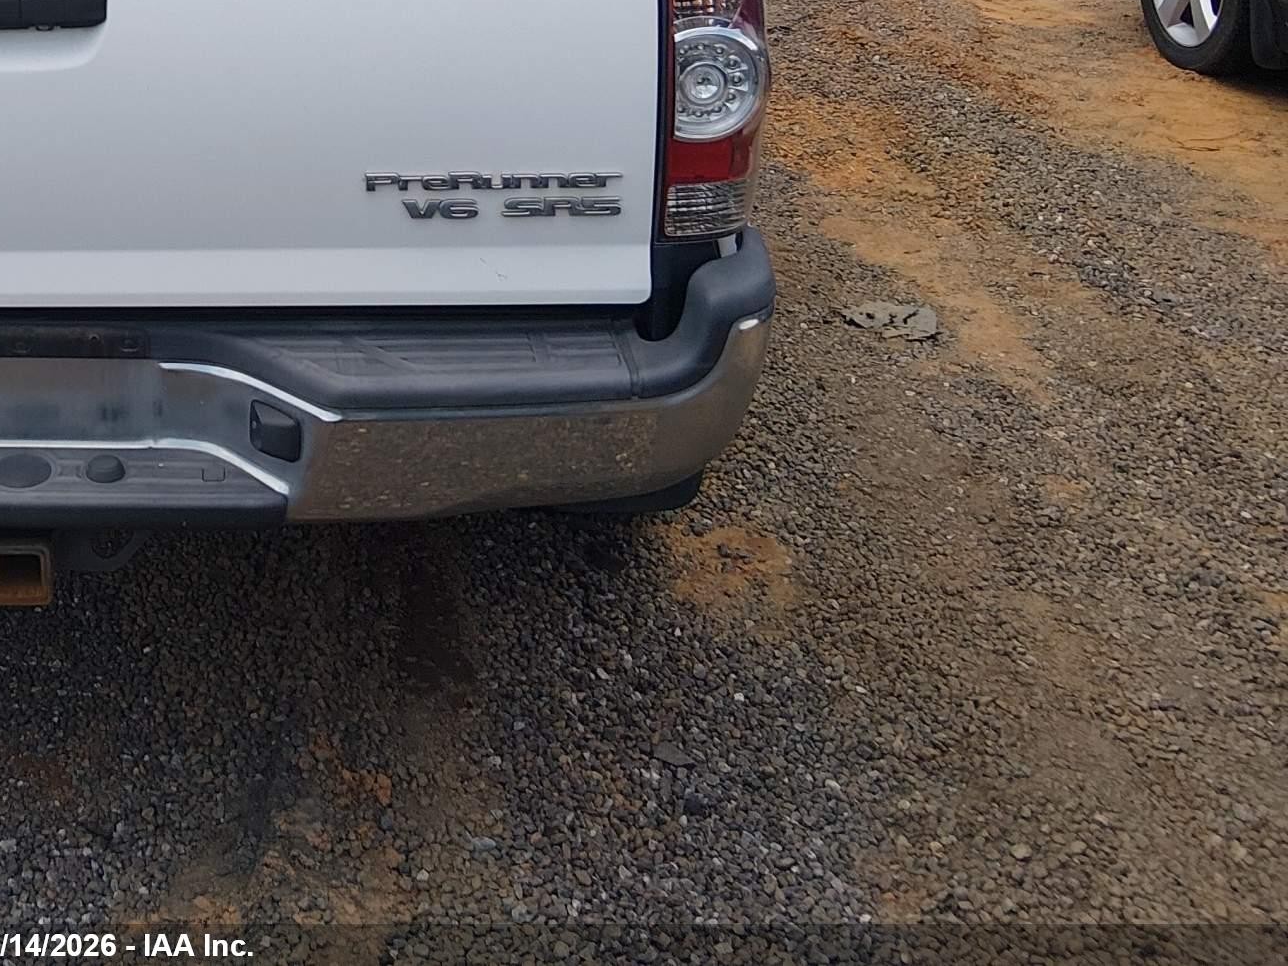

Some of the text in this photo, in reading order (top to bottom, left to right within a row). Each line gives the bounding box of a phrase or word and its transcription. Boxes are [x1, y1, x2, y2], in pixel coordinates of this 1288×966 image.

[364, 171, 623, 191] PreRunner
[402, 196, 623, 219] V6 SR5
